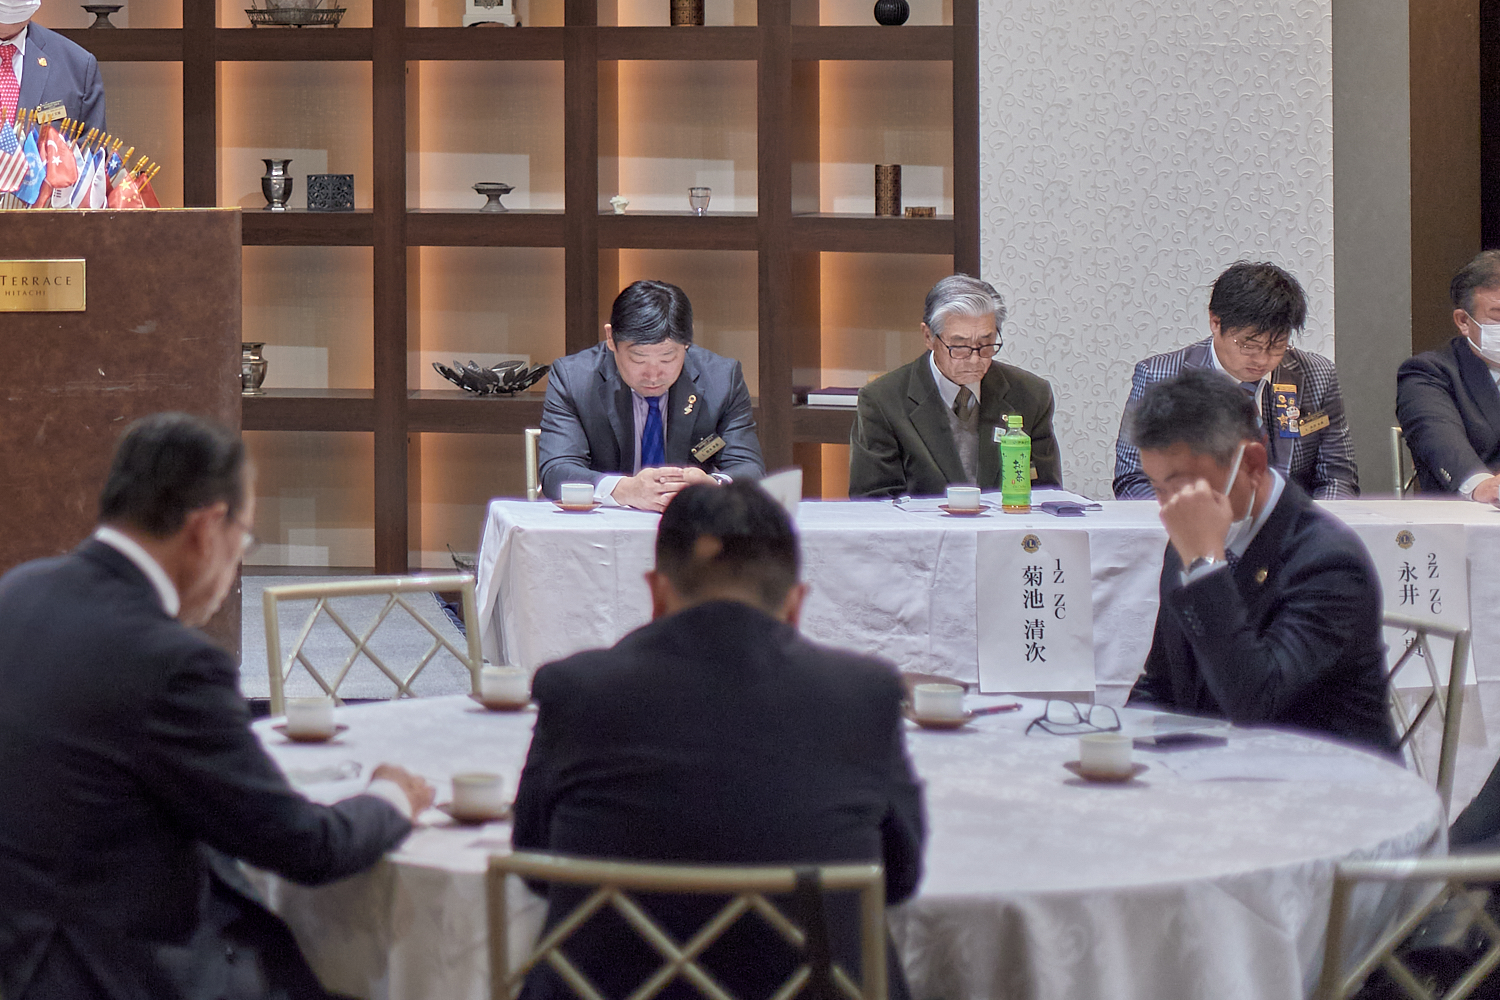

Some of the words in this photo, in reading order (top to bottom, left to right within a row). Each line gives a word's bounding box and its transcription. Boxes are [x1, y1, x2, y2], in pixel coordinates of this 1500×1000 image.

[5, 289, 47, 297] HITACHI
[1021, 565, 1045, 610] 菊池
[1398, 561, 1420, 607] 永井
[1023, 618, 1047, 664] 清次
